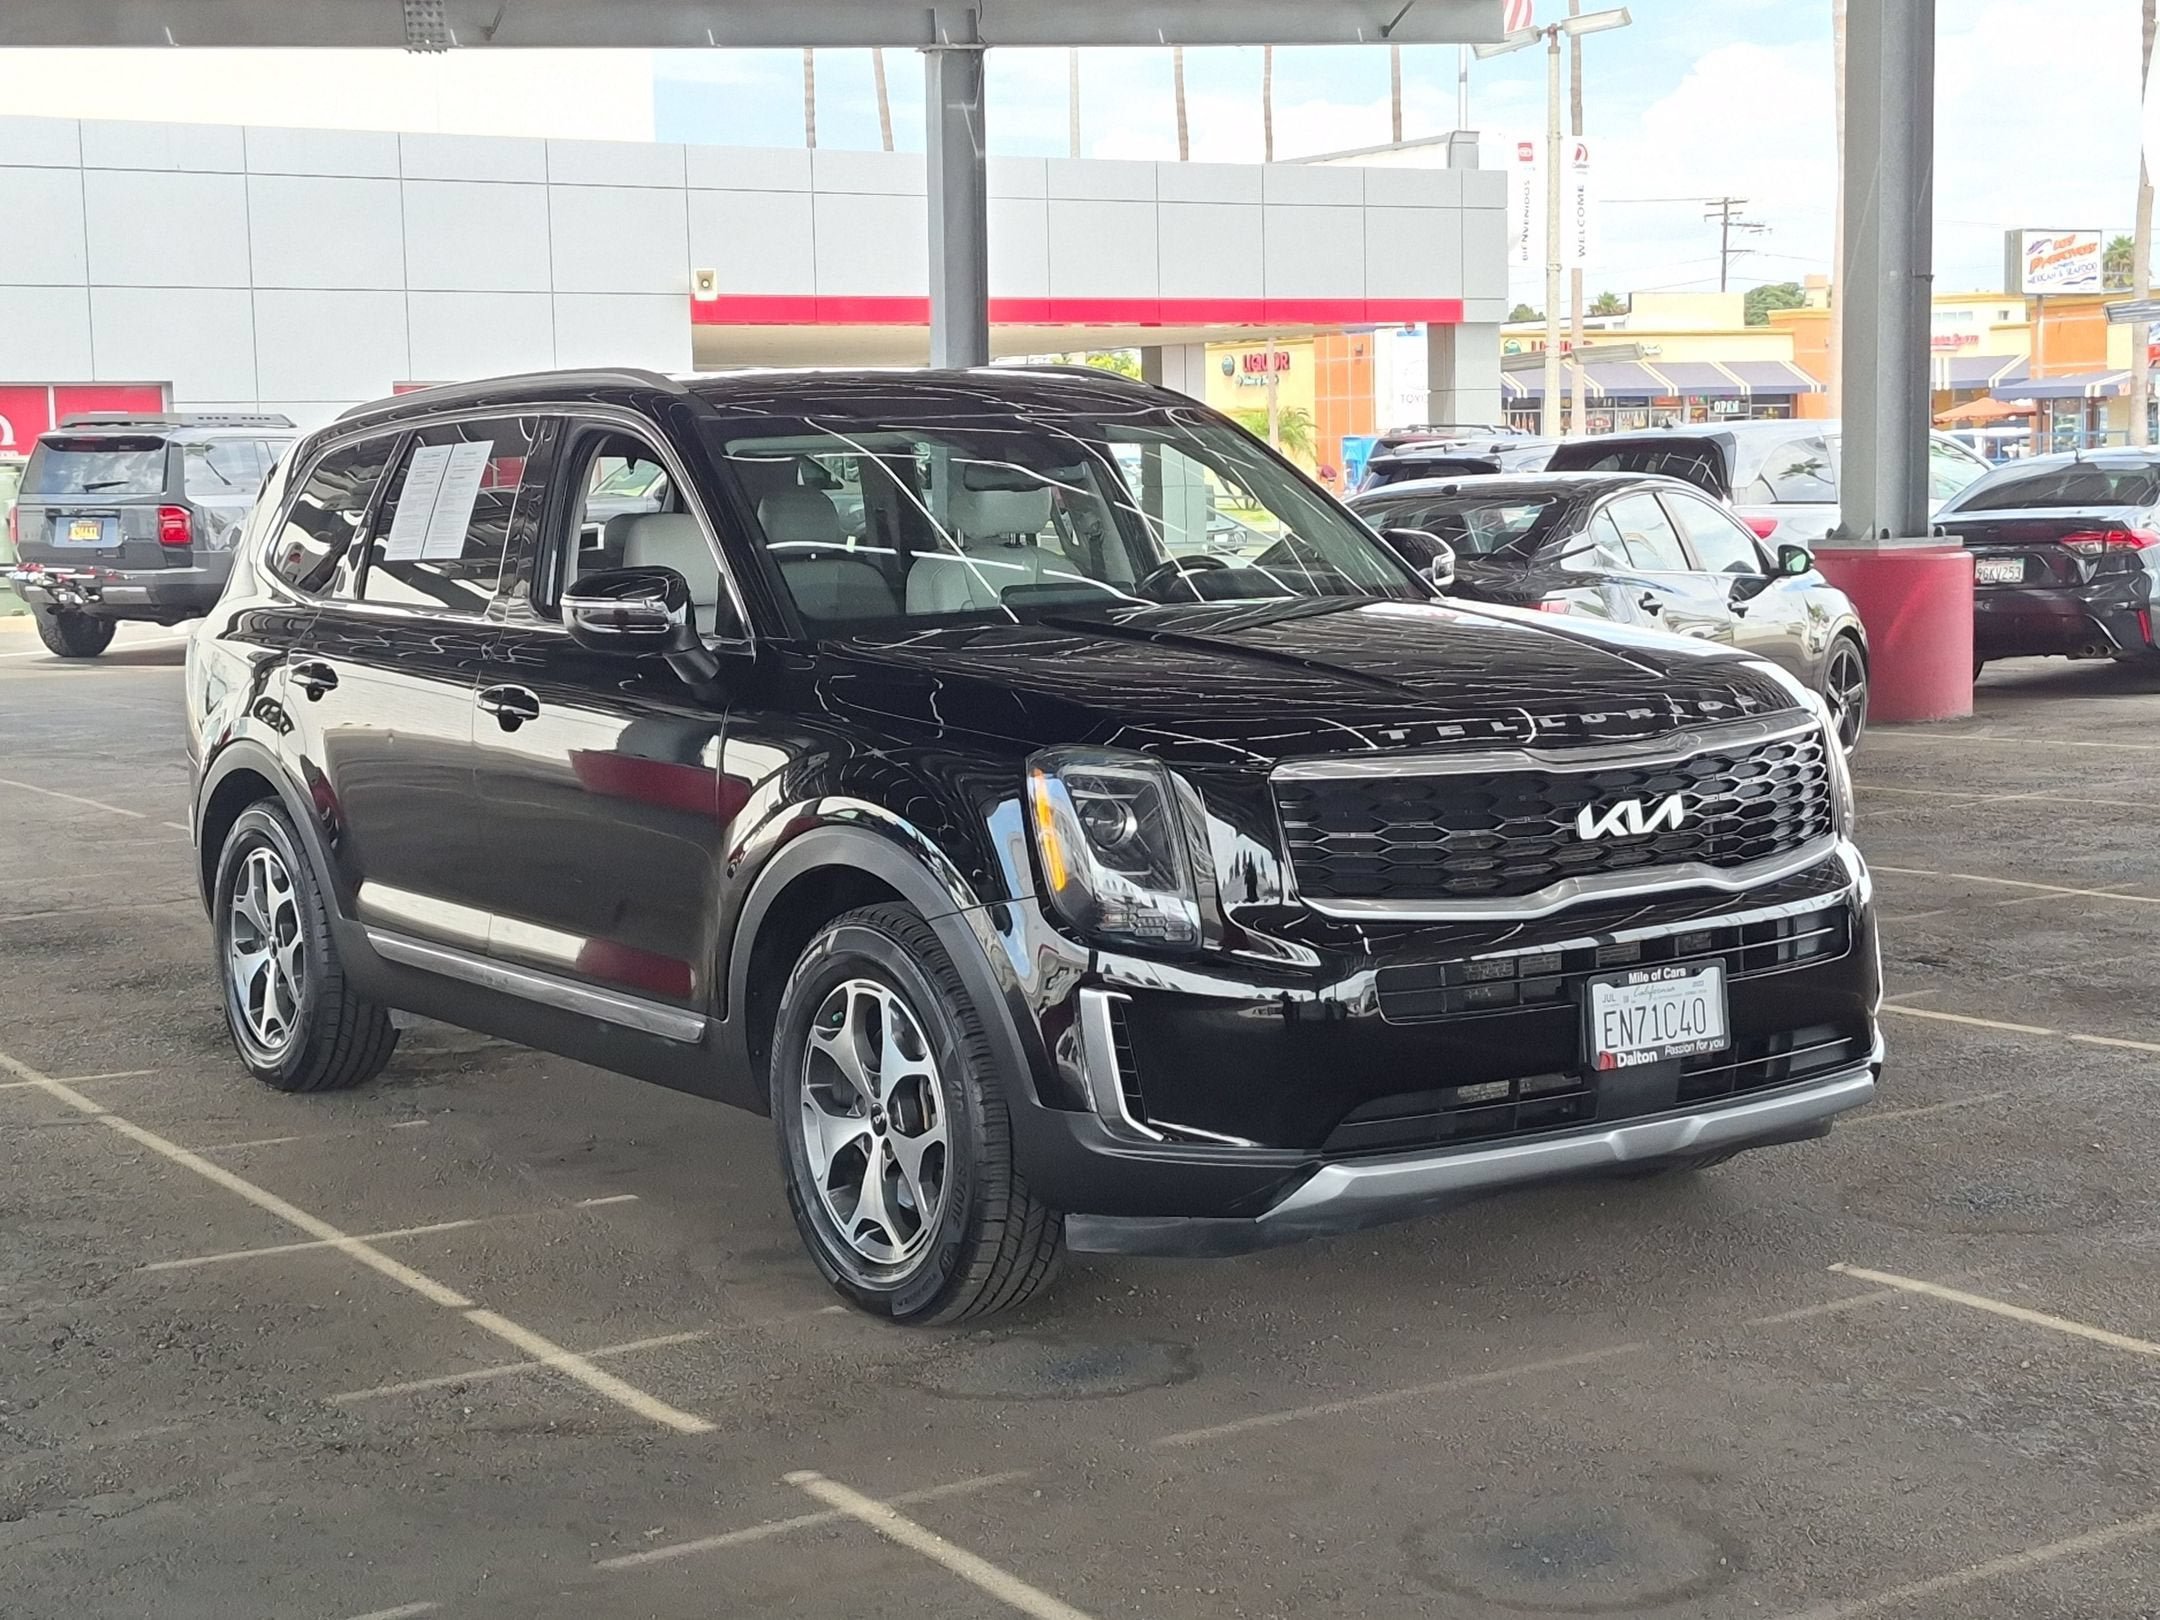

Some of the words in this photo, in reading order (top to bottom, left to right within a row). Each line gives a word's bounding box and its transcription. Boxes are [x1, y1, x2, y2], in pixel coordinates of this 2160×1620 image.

[1577, 185, 1585, 257] WELCOME
[1714, 400, 1740, 413] OPEN
[1977, 566, 2021, 580] 9GKV253
[1378, 695, 1757, 740] TELLURIDE
[1577, 792, 1684, 840] KIA
[1628, 971, 1649, 984] Mile
[1651, 968, 1662, 981] of
[1663, 967, 1687, 979] Cars
[1602, 993, 1617, 1003] JUL
[1633, 985, 1676, 1001] California
[1604, 997, 1706, 1049] EN71C40
[1664, 1041, 1695, 1056] Passion
[1695, 1038, 1709, 1051] for
[1708, 1038, 1725, 1051] you
[1617, 1051, 1658, 1067] Dalton
